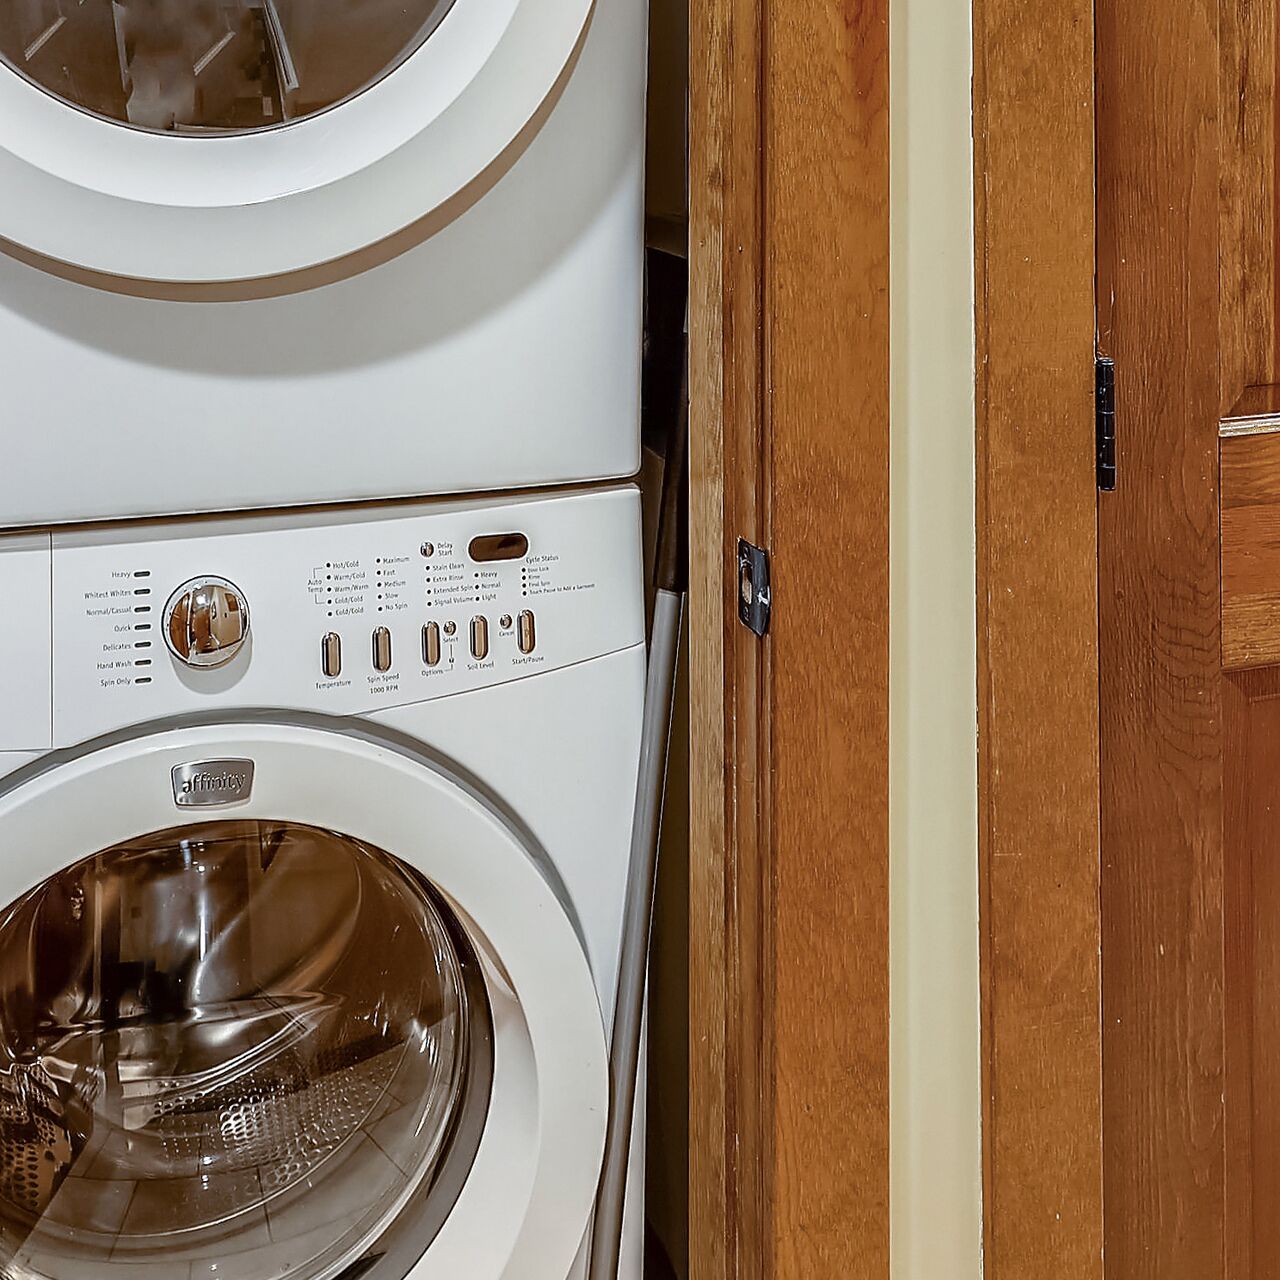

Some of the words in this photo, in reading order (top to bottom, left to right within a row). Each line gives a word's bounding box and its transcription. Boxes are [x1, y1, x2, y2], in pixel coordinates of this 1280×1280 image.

[437, 542, 453, 551] Delay
[438, 549, 453, 557] Start
[332, 560, 359, 570] Hot/Cold
[382, 556, 410, 565] Maximum
[526, 556, 540, 565] Cycle
[541, 555, 559, 563] Status
[432, 564, 448, 572] Stain
[111, 570, 131, 580] Heavy
[333, 572, 366, 581] Warm/Cold
[480, 571, 498, 579] Heavy
[307, 579, 323, 587] Auto
[334, 583, 369, 593] Warm/Warm
[384, 580, 406, 588] Medium
[481, 581, 501, 590] Normal
[84, 591, 109, 600] Whitest
[110, 589, 132, 598] Whites
[433, 585, 460, 595] Extended
[334, 595, 364, 605] Cold/Cold
[384, 592, 399, 600] Slow
[481, 593, 497, 601] Light
[394, 602, 408, 611] Spin
[434, 598, 452, 608] Signal
[86, 606, 132, 617] Normal/Casual
[114, 624, 131, 632] Quick
[102, 642, 132, 652] Delicates
[96, 661, 114, 670] Hand
[115, 659, 132, 669] Wash
[467, 663, 479, 671] Soil
[479, 661, 495, 670] Level
[512, 656, 544, 666] Start/Pause
[421, 668, 444, 678] Options
[100, 679, 115, 688] Spin
[116, 677, 132, 686] Only
[367, 675, 381, 685] Spin
[381, 673, 400, 683] Speed
[315, 680, 352, 690] Temperature
[370, 686, 385, 695] 1000
[386, 684, 399, 693] RPM
[182, 771, 247, 795] affinity
